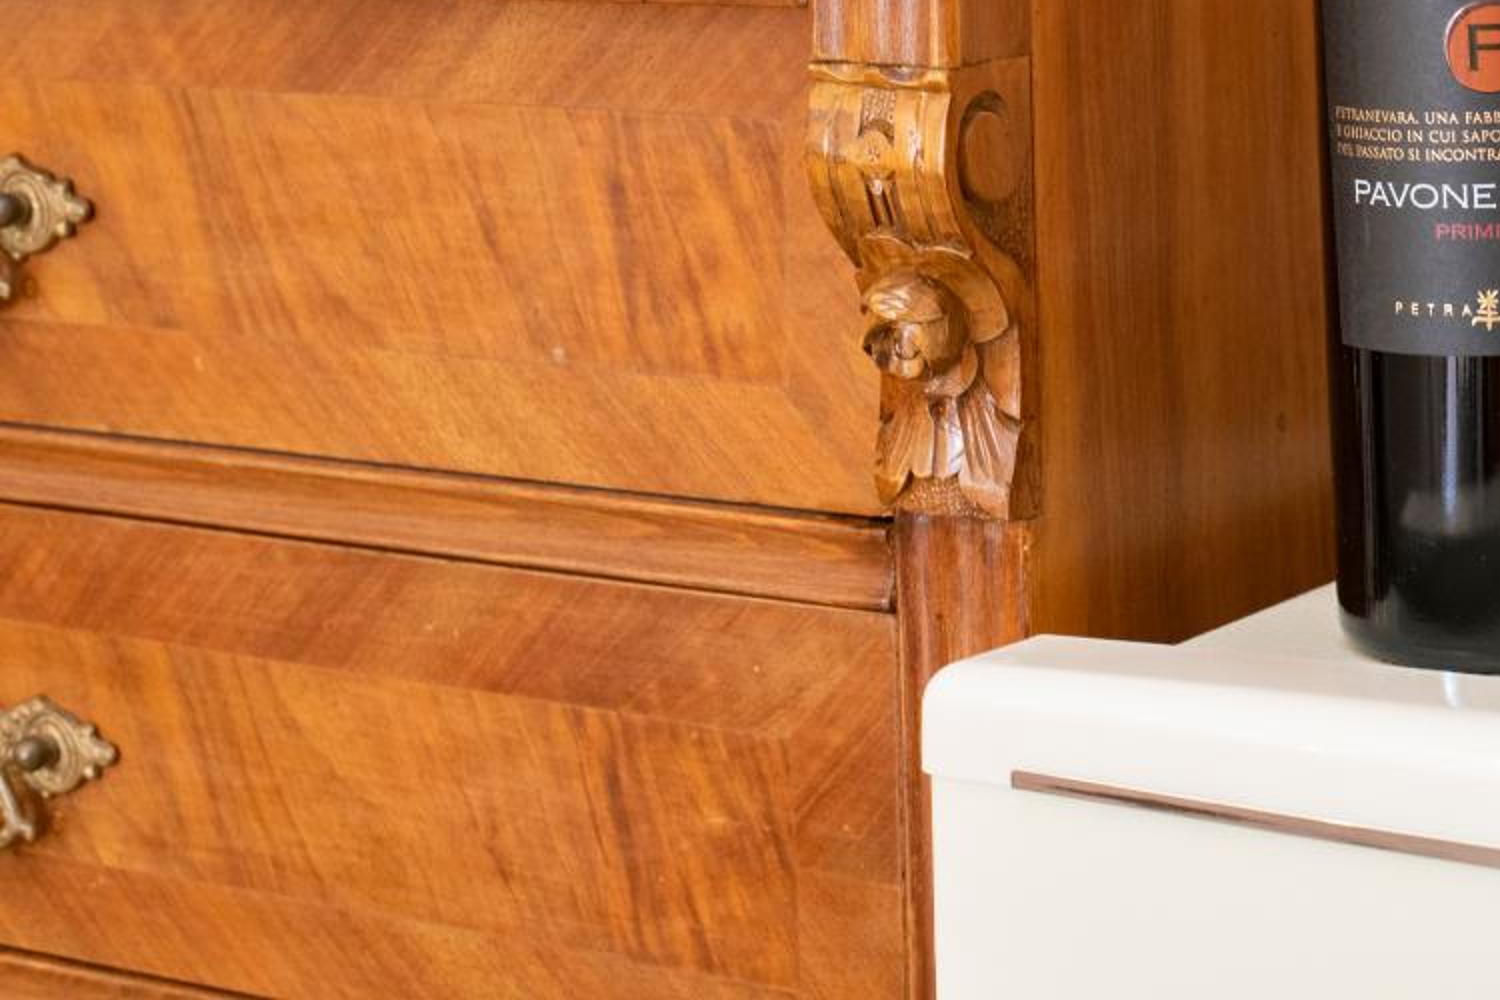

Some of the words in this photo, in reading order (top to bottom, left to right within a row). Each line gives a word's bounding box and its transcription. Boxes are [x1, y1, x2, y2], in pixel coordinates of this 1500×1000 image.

[1425, 111, 1459, 125] UNA
[1407, 130, 1423, 143] IN
[1429, 130, 1456, 143] CUI
[1355, 143, 1404, 161] PASSATO
[1408, 147, 1420, 161] SI
[1354, 178, 1497, 210] PAVONE
[1394, 301, 1473, 317] PETRA
